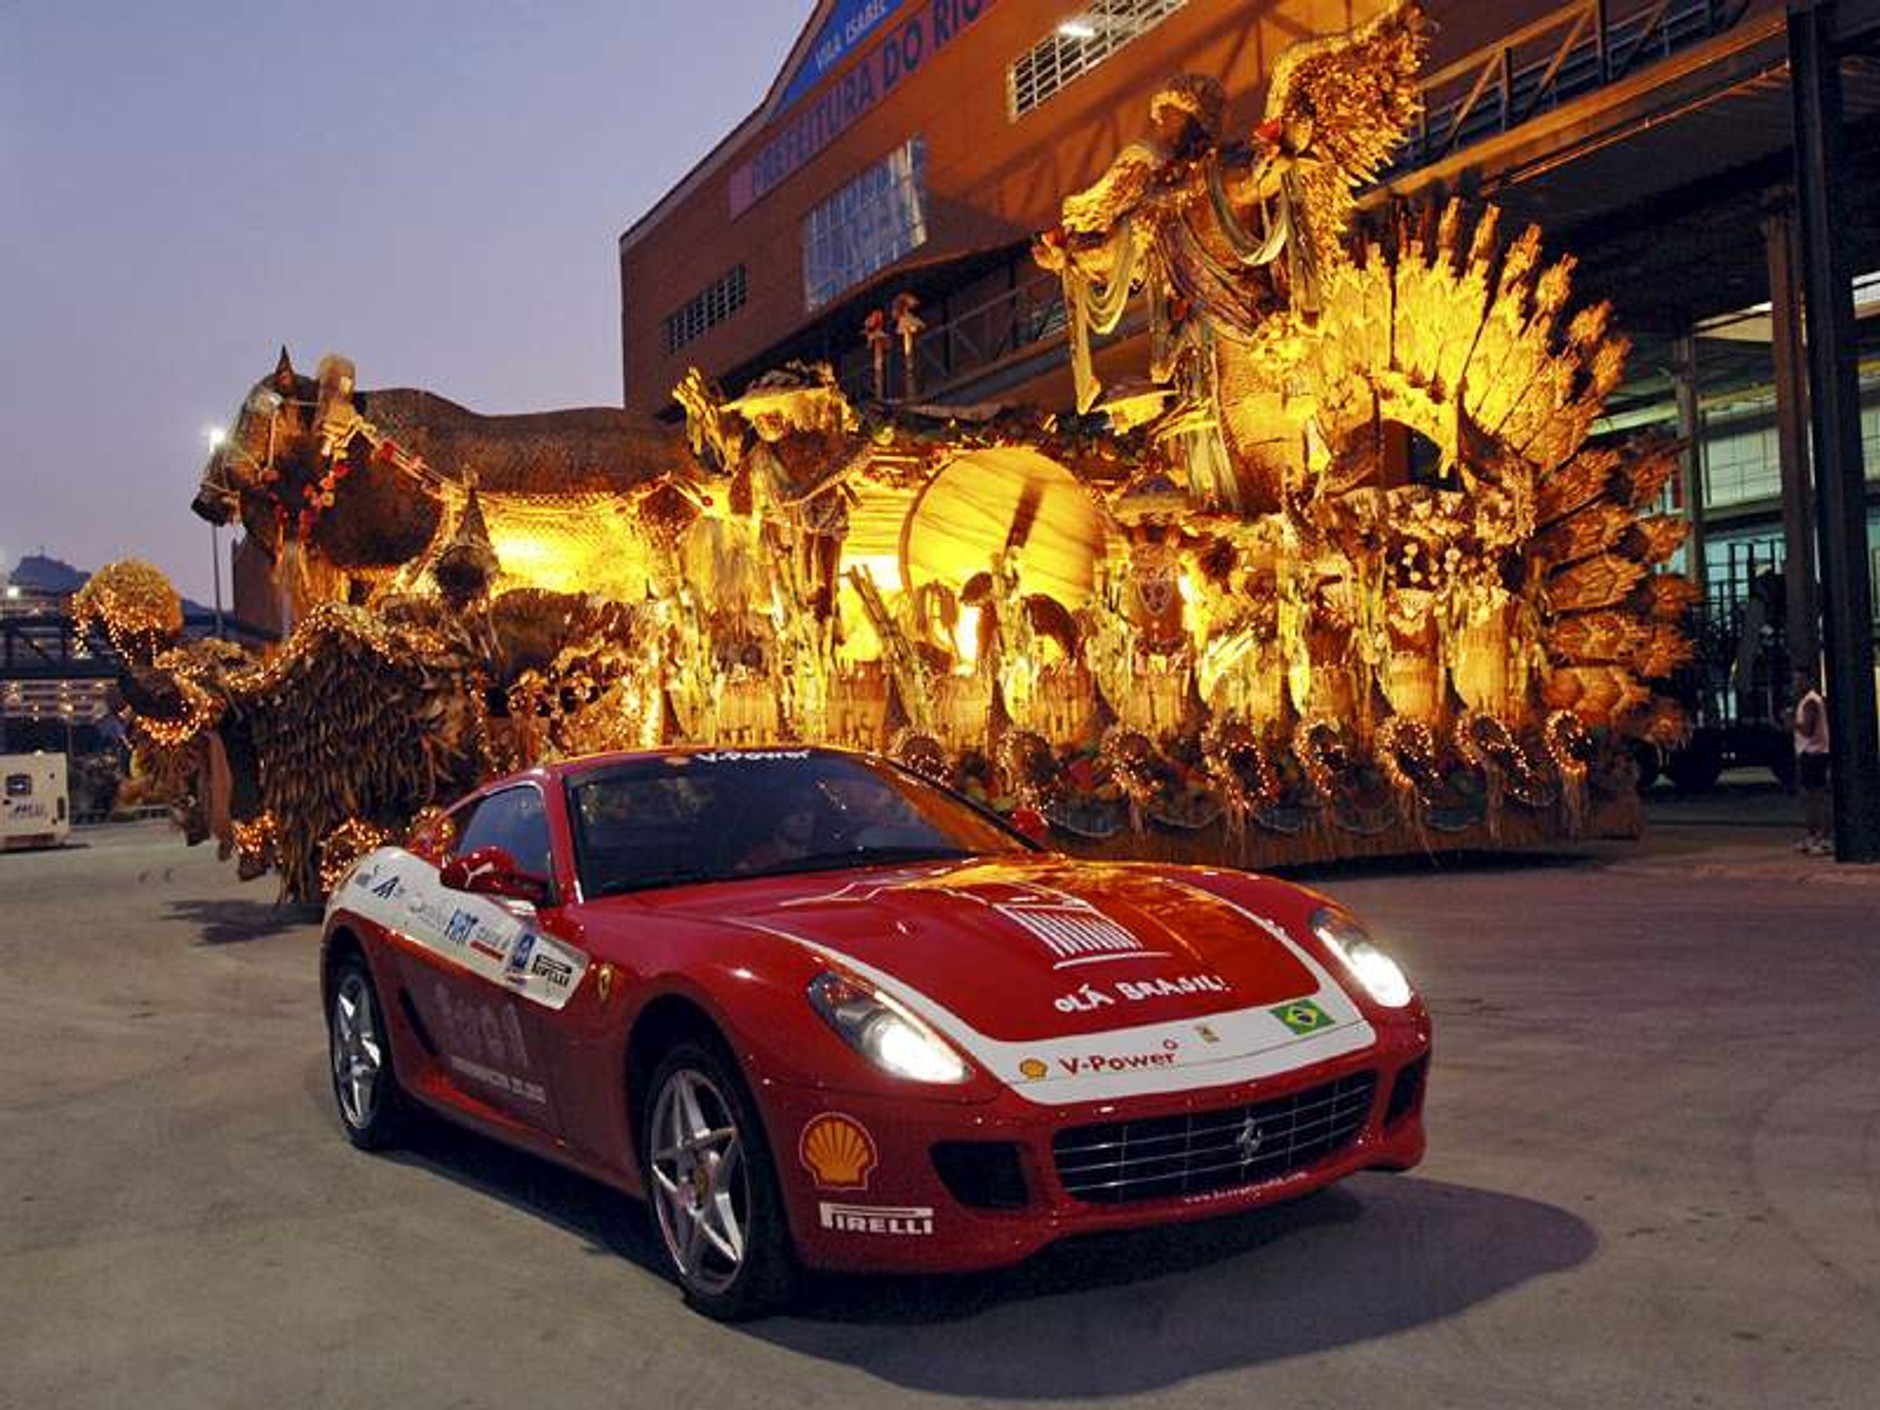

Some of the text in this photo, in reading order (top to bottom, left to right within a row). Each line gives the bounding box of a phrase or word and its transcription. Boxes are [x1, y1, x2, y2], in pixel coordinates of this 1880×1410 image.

[750, 57, 877, 198] PREFEITURA
[883, 19, 923, 87] DO
[1115, 974, 1232, 1001] BRASIL!
[1059, 1051, 1177, 1075] V-Power
[819, 1202, 934, 1235] PIRELLI
